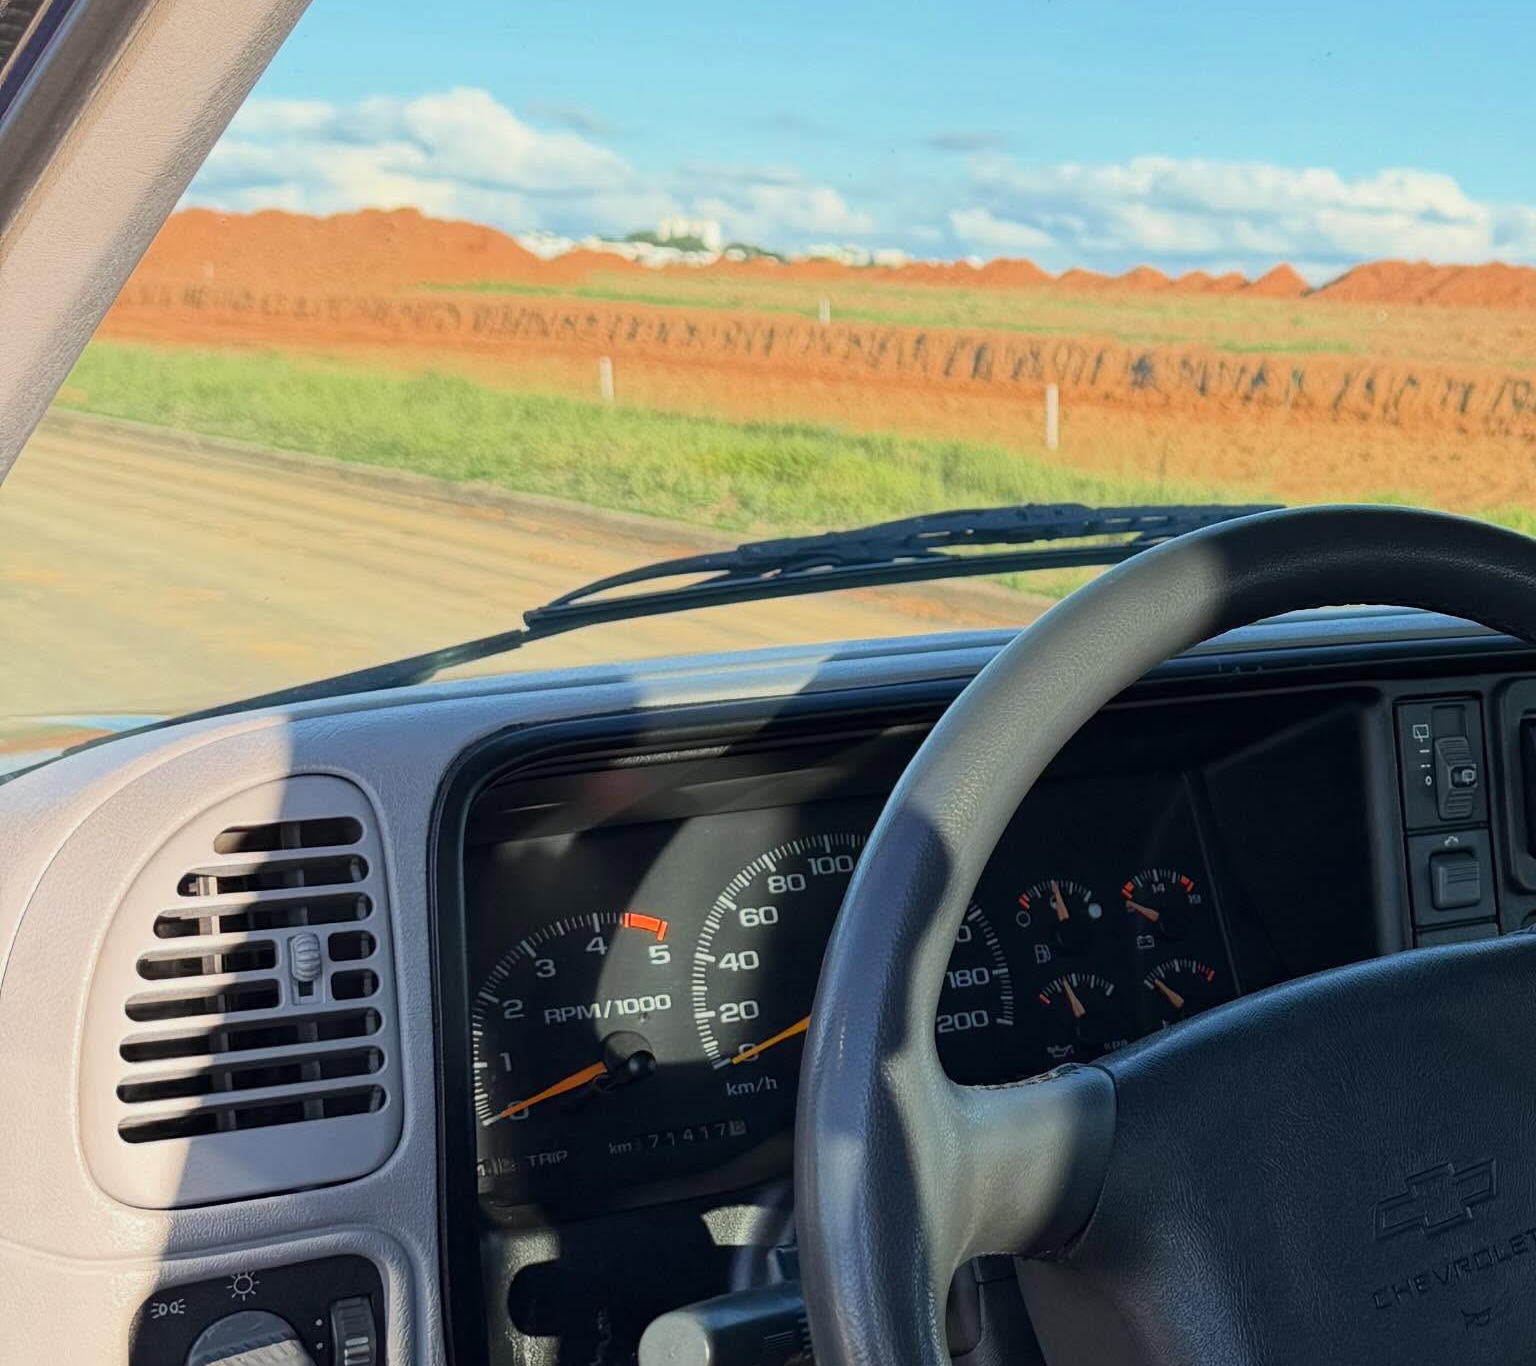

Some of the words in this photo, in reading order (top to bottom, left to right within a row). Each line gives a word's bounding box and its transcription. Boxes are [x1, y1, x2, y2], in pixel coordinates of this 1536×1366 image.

[808, 855, 854, 875] 100
[767, 874, 806, 894] 80
[739, 906, 779, 927] 60
[585, 936, 608, 955] 4
[648, 944, 671, 964] 5
[535, 959, 557, 978] 3
[718, 950, 760, 971] 40
[946, 967, 990, 989] 180
[503, 999, 525, 1019] 2
[544, 994, 672, 1024] RPM/1000
[719, 1000, 760, 1023] 20
[936, 1010, 990, 1033] 200
[500, 1052, 512, 1072] 1
[726, 1076, 777, 1096] km/h
[527, 1150, 568, 1167] TRIP
